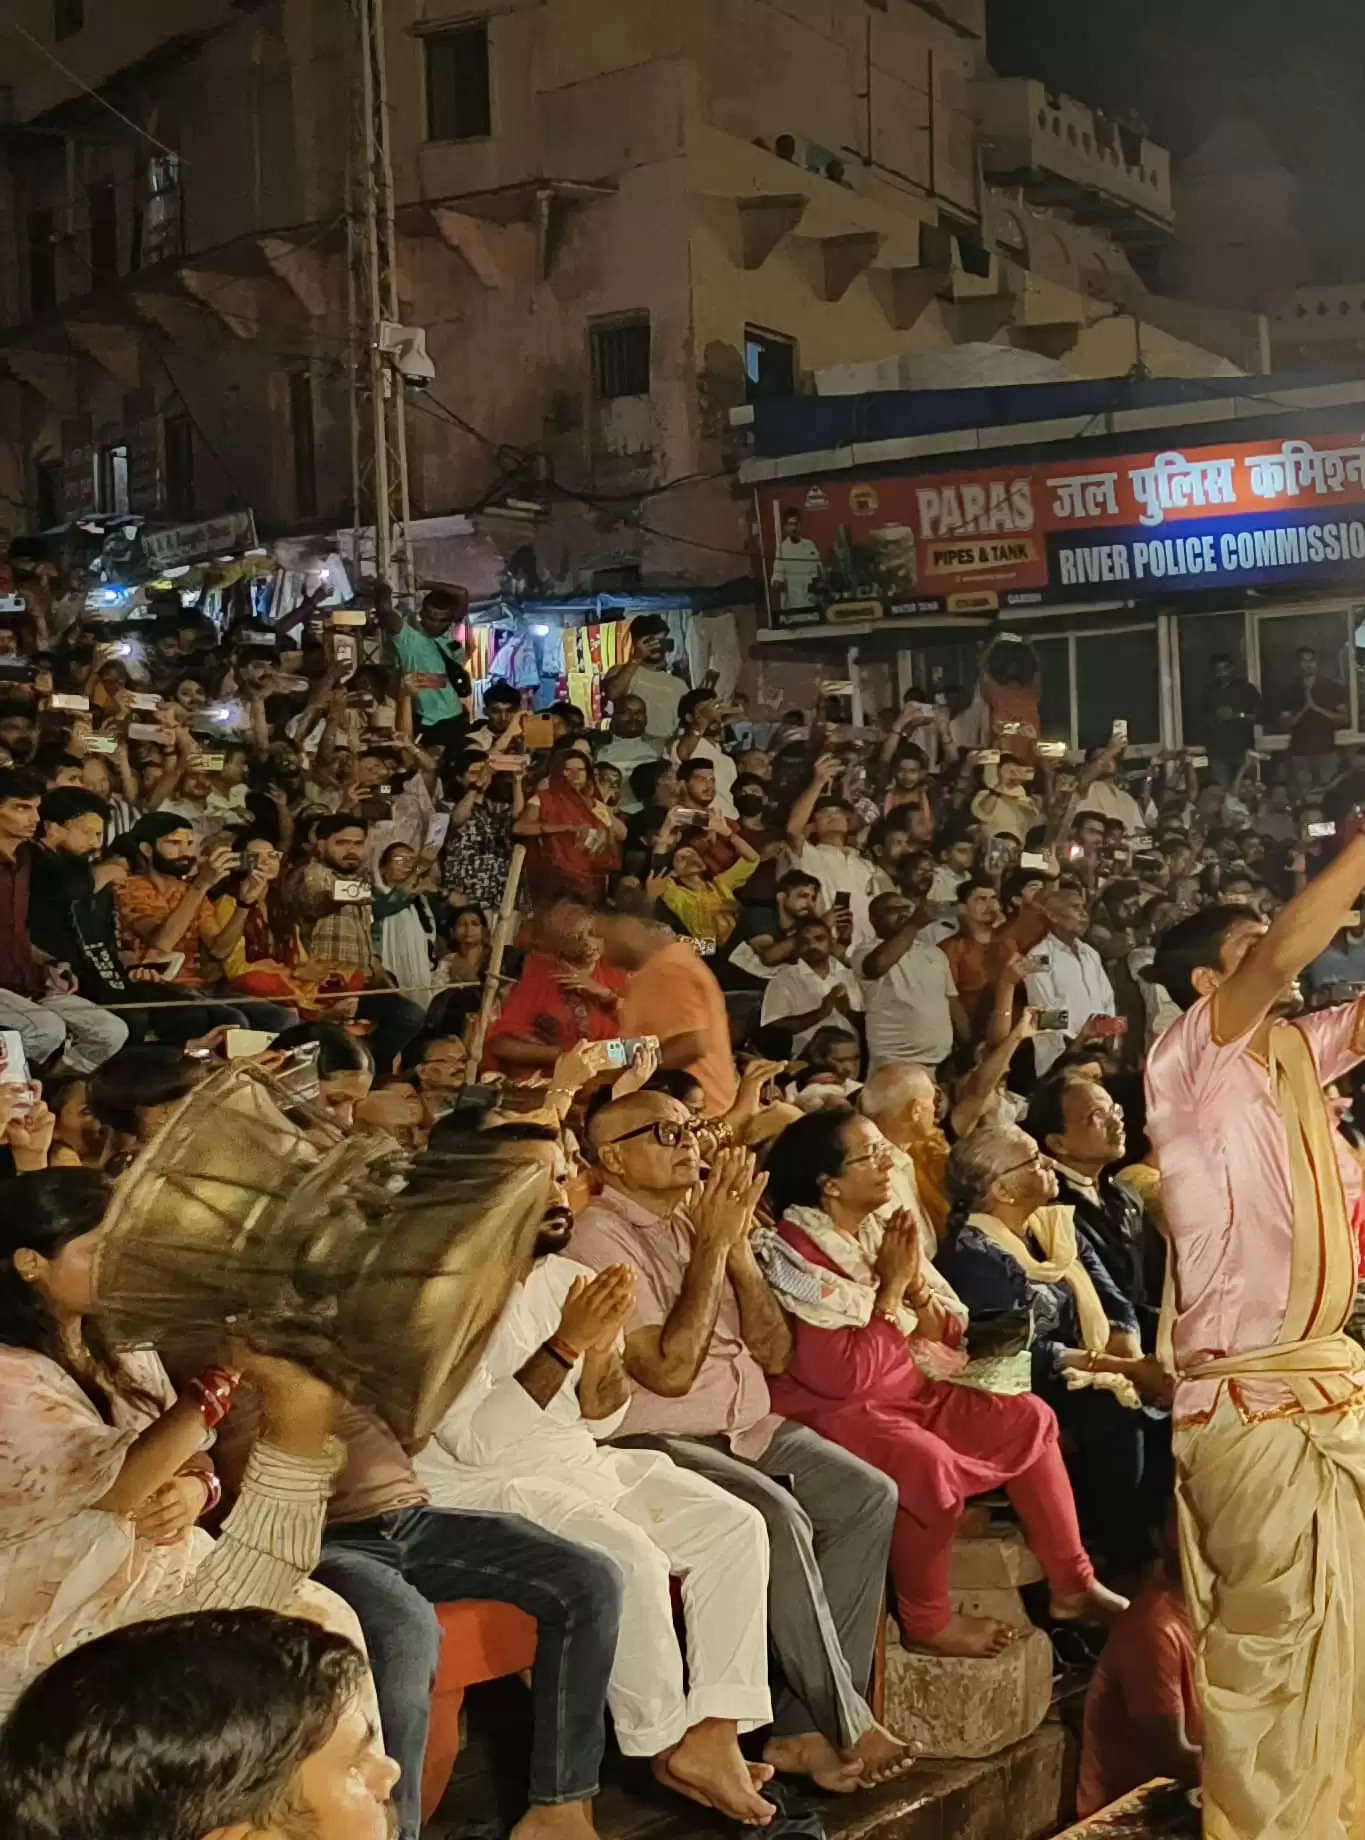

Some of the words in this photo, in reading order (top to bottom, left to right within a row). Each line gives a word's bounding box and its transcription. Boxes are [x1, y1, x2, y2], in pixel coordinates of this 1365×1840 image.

[915, 477, 1035, 540] PARAS
[1046, 472, 1120, 518] जल
[1129, 451, 1236, 527] पुलिस
[933, 548, 975, 567] PIPES
[978, 546, 989, 563] &
[990, 543, 1029, 562] TANK
[1059, 543, 1130, 585] RIVER
[1133, 535, 1217, 579] POLICE
